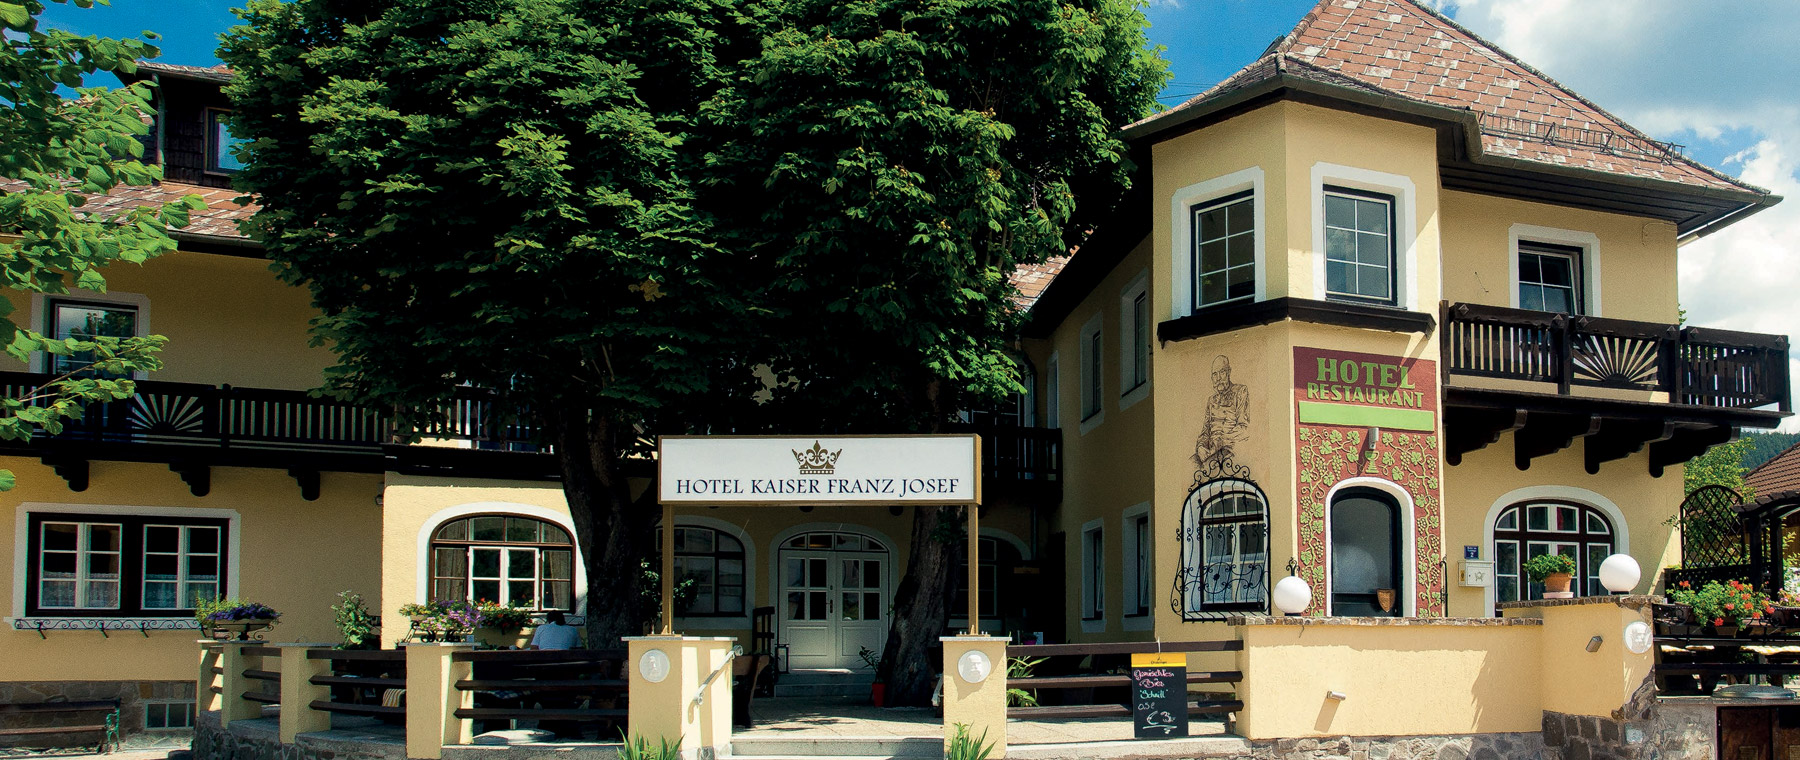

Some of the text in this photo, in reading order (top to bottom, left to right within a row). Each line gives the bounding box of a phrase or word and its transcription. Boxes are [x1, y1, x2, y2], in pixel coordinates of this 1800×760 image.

[1316, 357, 1416, 390] HOTEL
[1307, 382, 1424, 408] RESTAURANT
[676, 478, 959, 497] HOTEL KAISER FRANZ JOSEF
